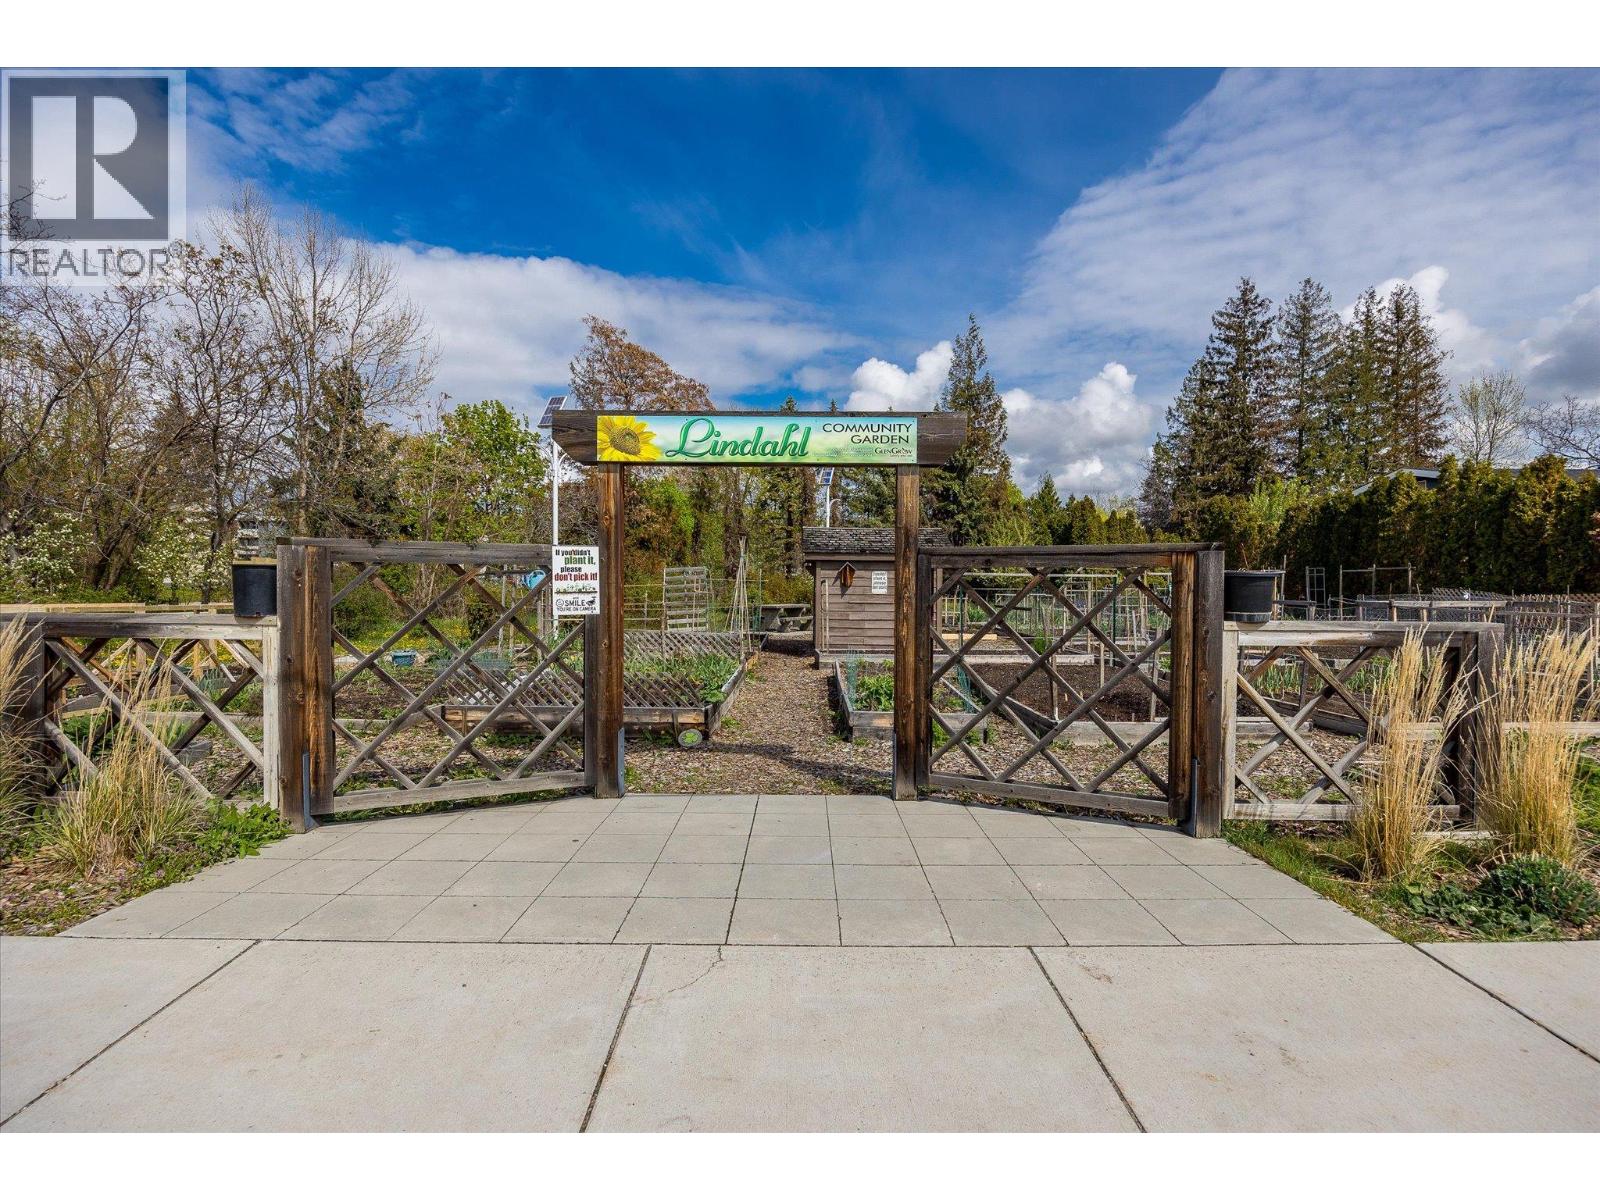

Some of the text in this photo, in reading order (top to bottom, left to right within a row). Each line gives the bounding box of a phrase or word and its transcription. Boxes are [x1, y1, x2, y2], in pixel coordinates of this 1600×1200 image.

[822, 423, 912, 433] COMMUNITY
[665, 418, 811, 458] Lindahl
[850, 434, 909, 445] GARDEN
[564, 556, 596, 565] plant it,
[555, 572, 572, 581] don't
[574, 572, 589, 582] pick
